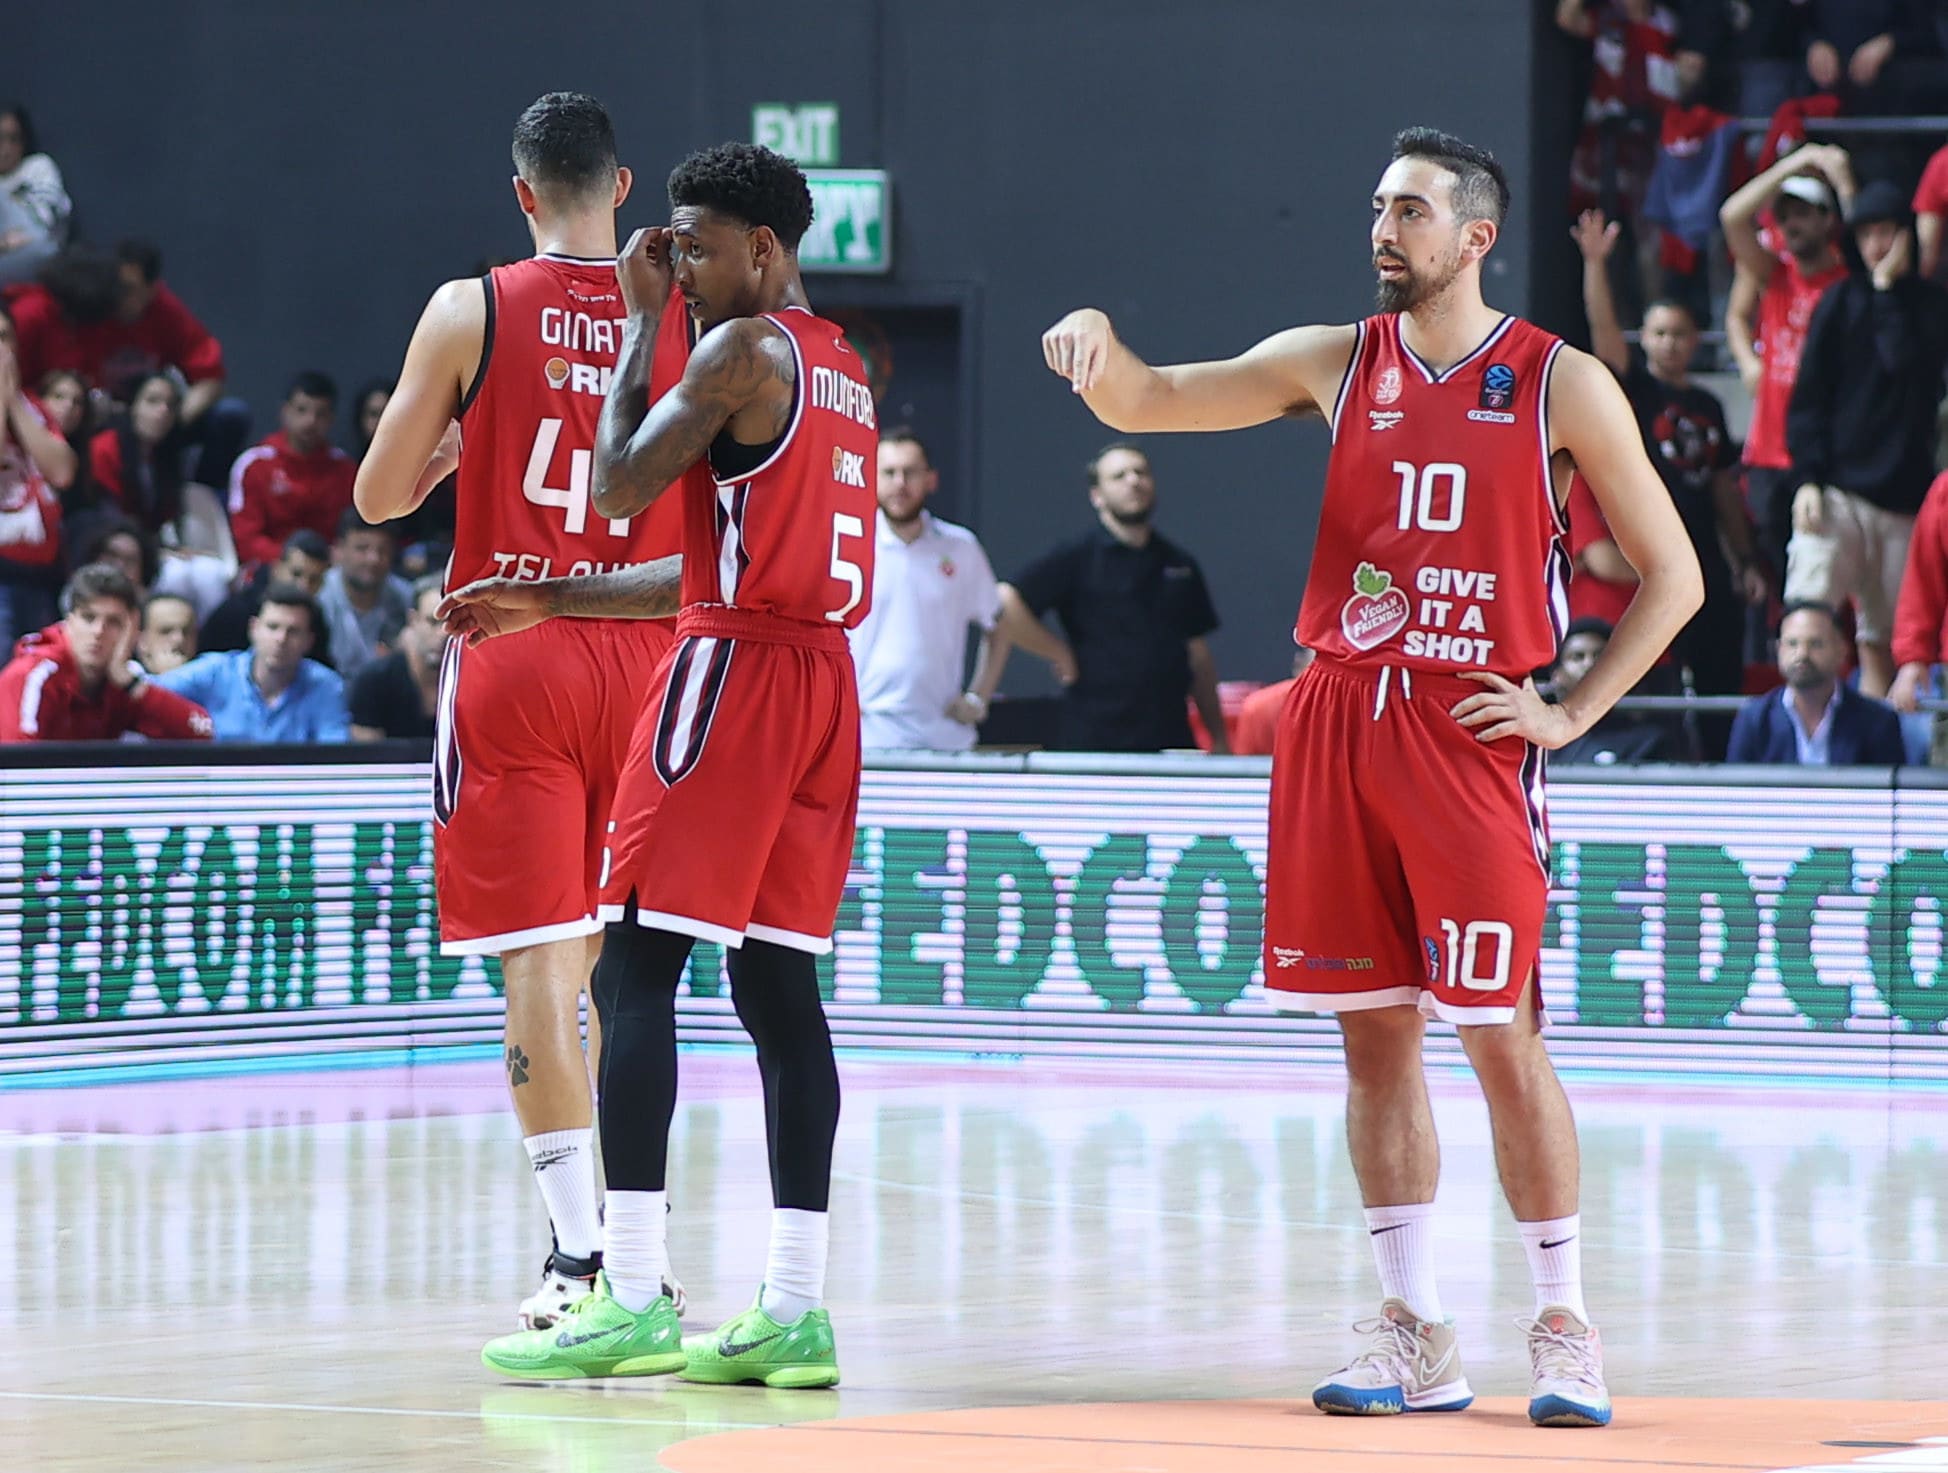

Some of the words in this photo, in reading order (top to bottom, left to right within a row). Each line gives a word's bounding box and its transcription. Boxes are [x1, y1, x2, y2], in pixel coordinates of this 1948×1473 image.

[754, 107, 838, 163] EXIT
[1393, 460, 1467, 532] 10
[825, 512, 864, 622] 5
[1416, 566, 1496, 601] GIVE
[1353, 603, 1404, 639] FRIENDLY
[1358, 595, 1399, 621] VEGAN
[1419, 598, 1452, 629] IT
[1459, 605, 1486, 633] A
[1403, 631, 1495, 665] SHOT
[1441, 917, 1513, 990] 10
